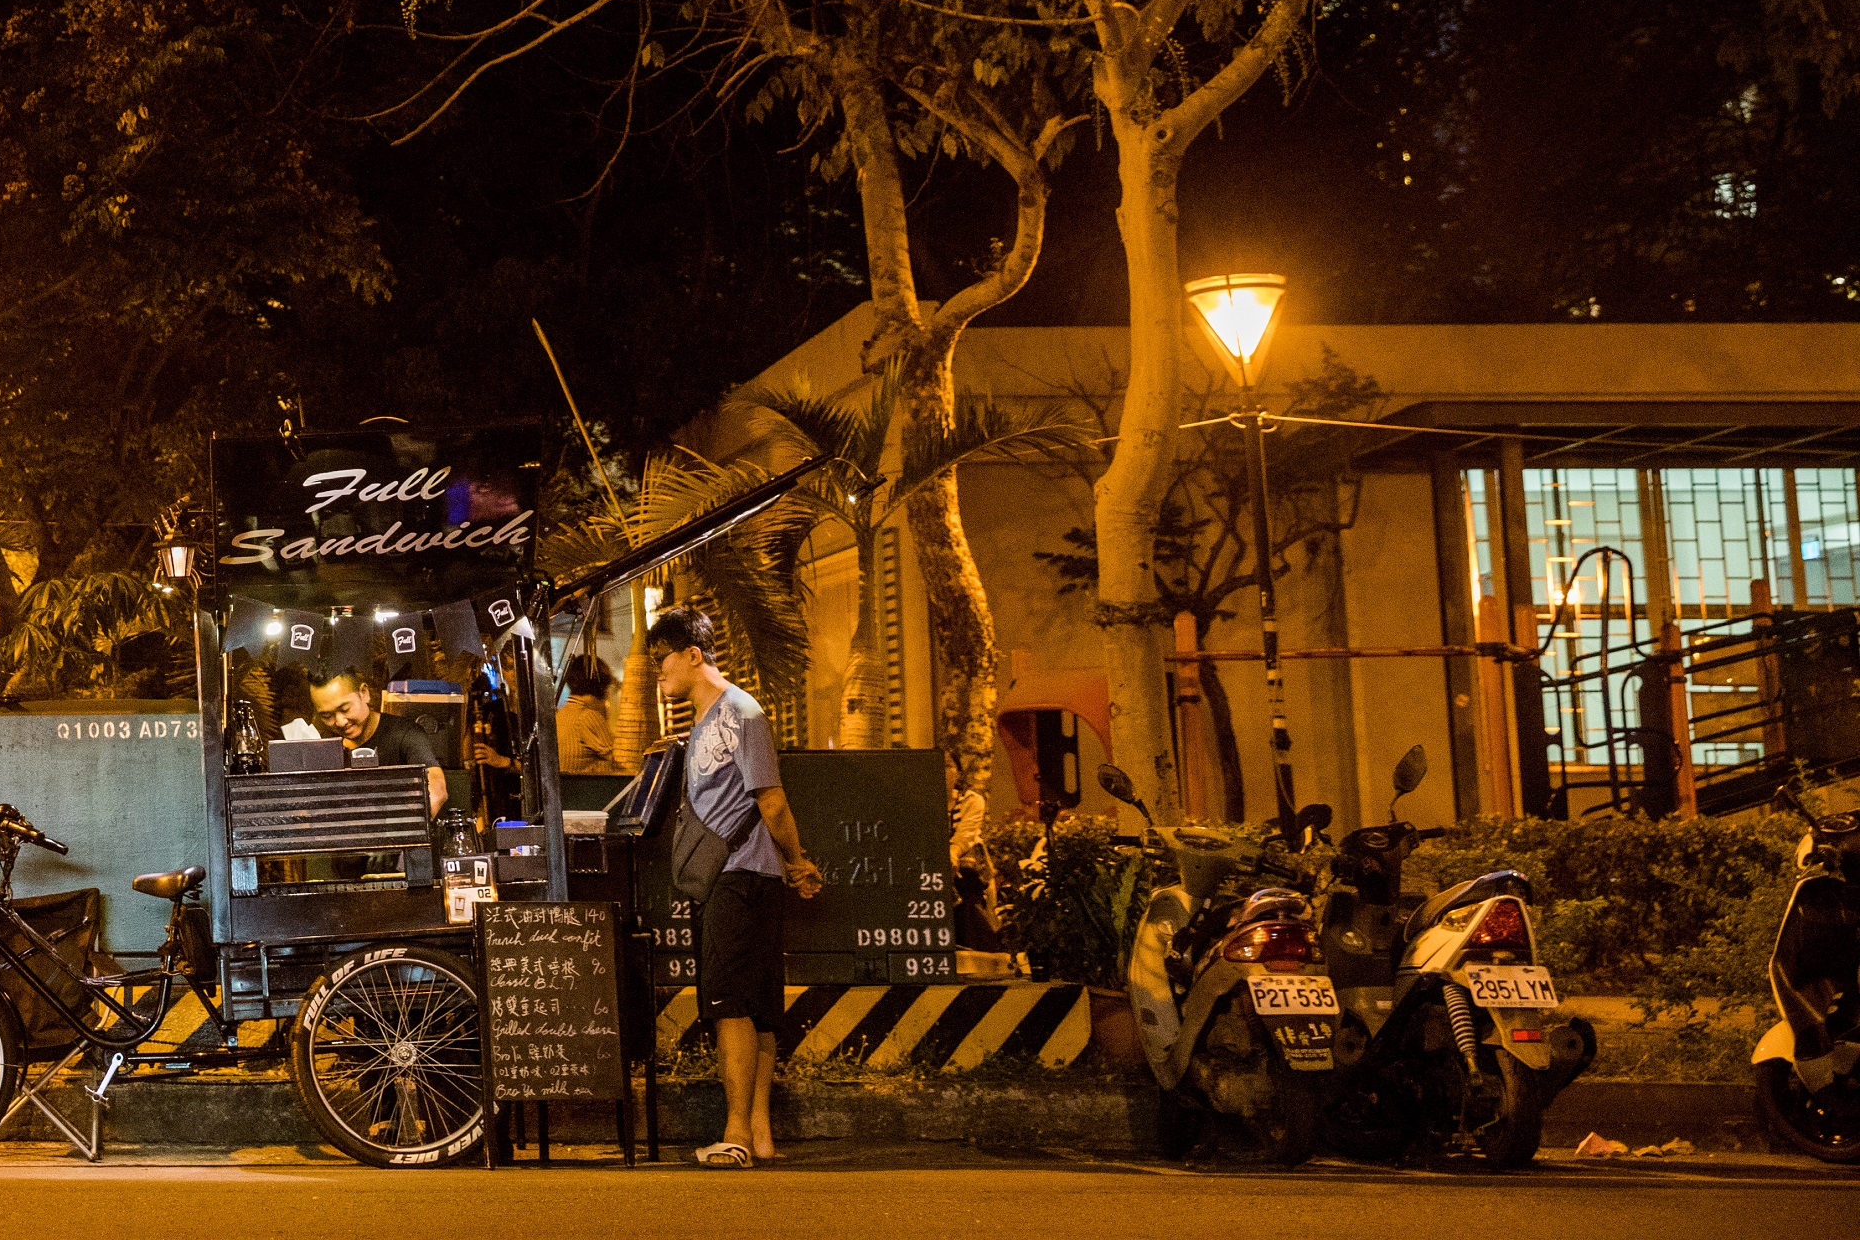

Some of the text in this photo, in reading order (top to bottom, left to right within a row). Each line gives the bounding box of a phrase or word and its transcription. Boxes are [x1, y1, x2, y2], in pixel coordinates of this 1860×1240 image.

[302, 465, 452, 514] Full
[219, 509, 535, 565] Sandwich
[492, 608, 510, 620] Full
[294, 632, 310, 642] Full
[397, 636, 412, 646] Full
[139, 720, 202, 739] AD73
[447, 861, 460, 872] 01
[920, 872, 944, 891] 25
[477, 888, 491, 899] 02
[585, 908, 606, 923] 140
[907, 900, 946, 919] 22.8
[486, 928, 602, 952] French duck confit
[857, 928, 951, 947] D98019
[591, 958, 606, 976] 90
[906, 956, 950, 977] 93.4
[303, 948, 408, 1031] FULL OF LIFE
[490, 974, 531, 988] Classic
[593, 998, 609, 1015] 60
[492, 1019, 531, 1040] Grilled
[535, 1022, 577, 1037] double
[541, 1080, 570, 1096] milk
[389, 1150, 439, 1164] DIET
